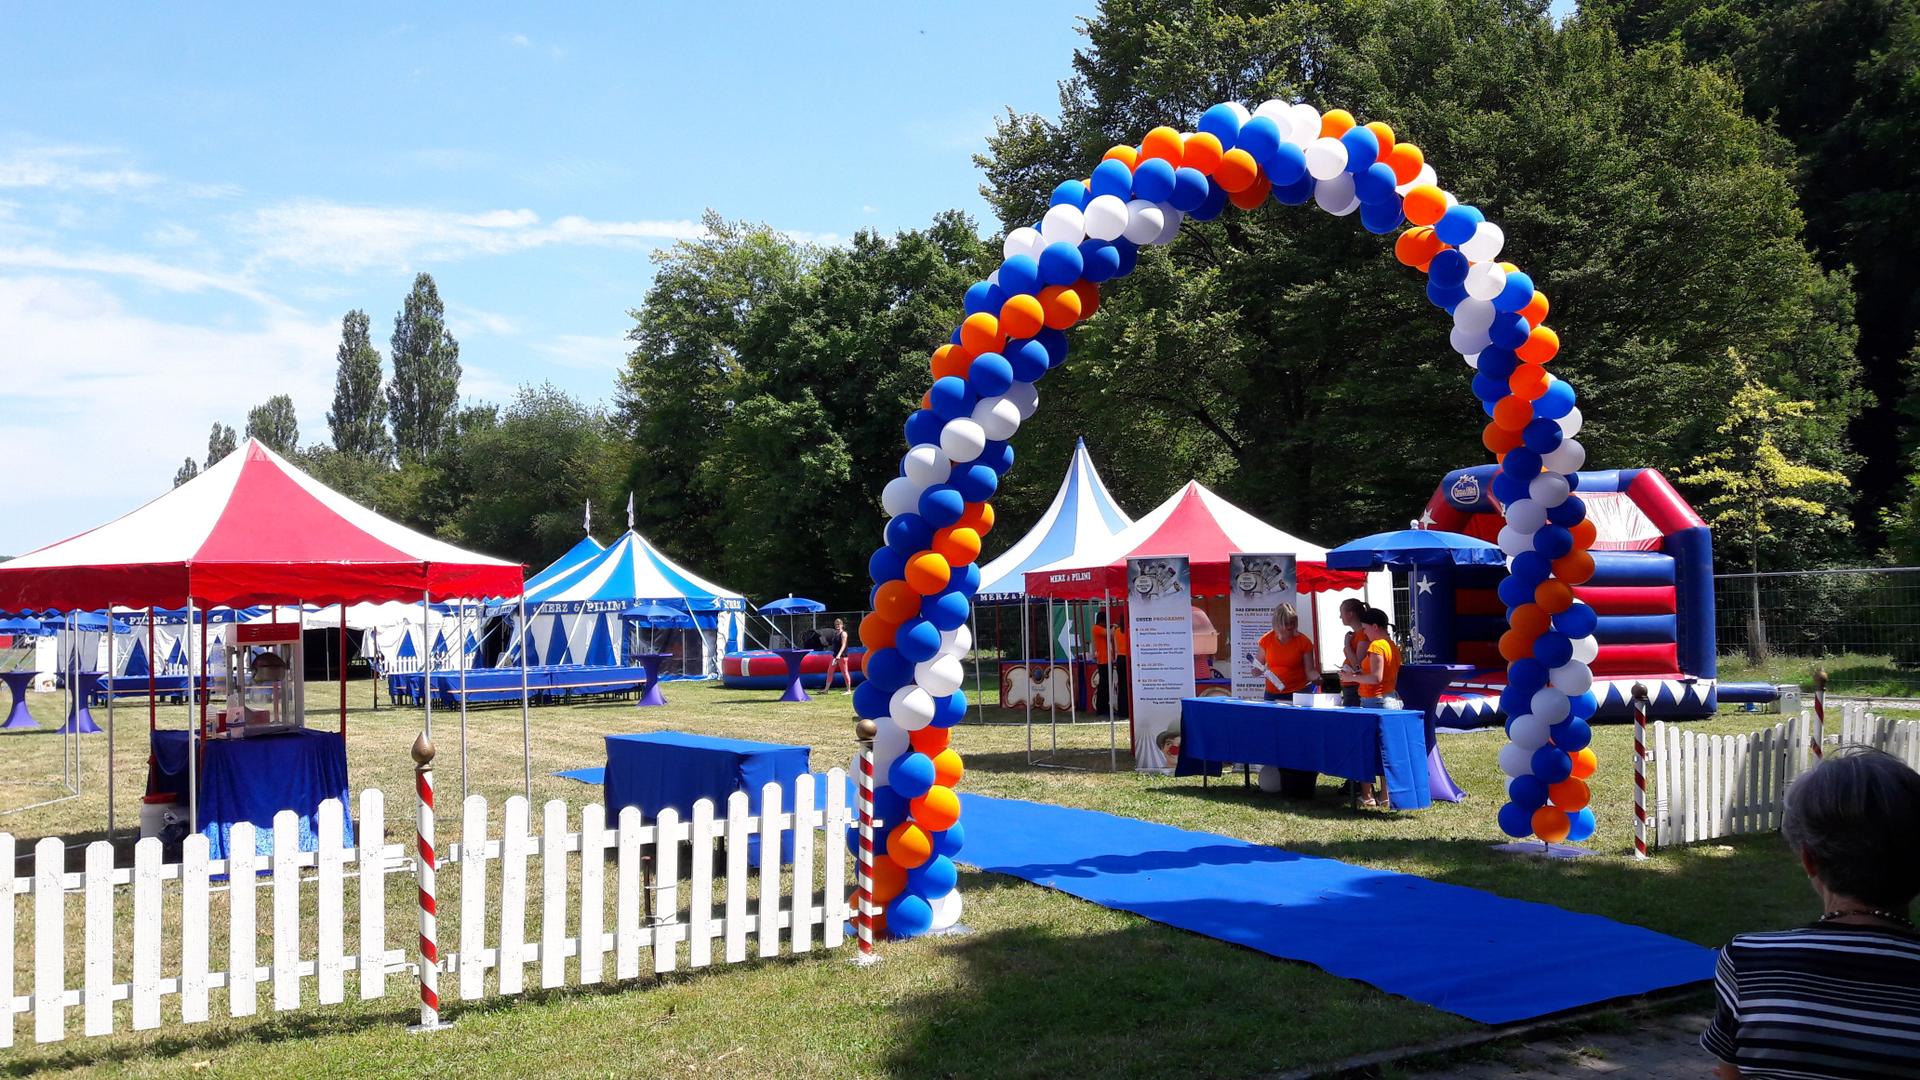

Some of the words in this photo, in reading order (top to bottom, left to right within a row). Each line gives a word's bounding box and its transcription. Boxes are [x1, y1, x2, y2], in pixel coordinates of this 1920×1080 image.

[1050, 574, 1066, 583] MERZ
[1072, 572, 1091, 581] PILINI
[980, 592, 1009, 601] MERZ
[541, 603, 569, 613] MERZ
[574, 604, 580, 612] &
[586, 601, 627, 612] PILINI
[129, 616, 168, 625] PINI
